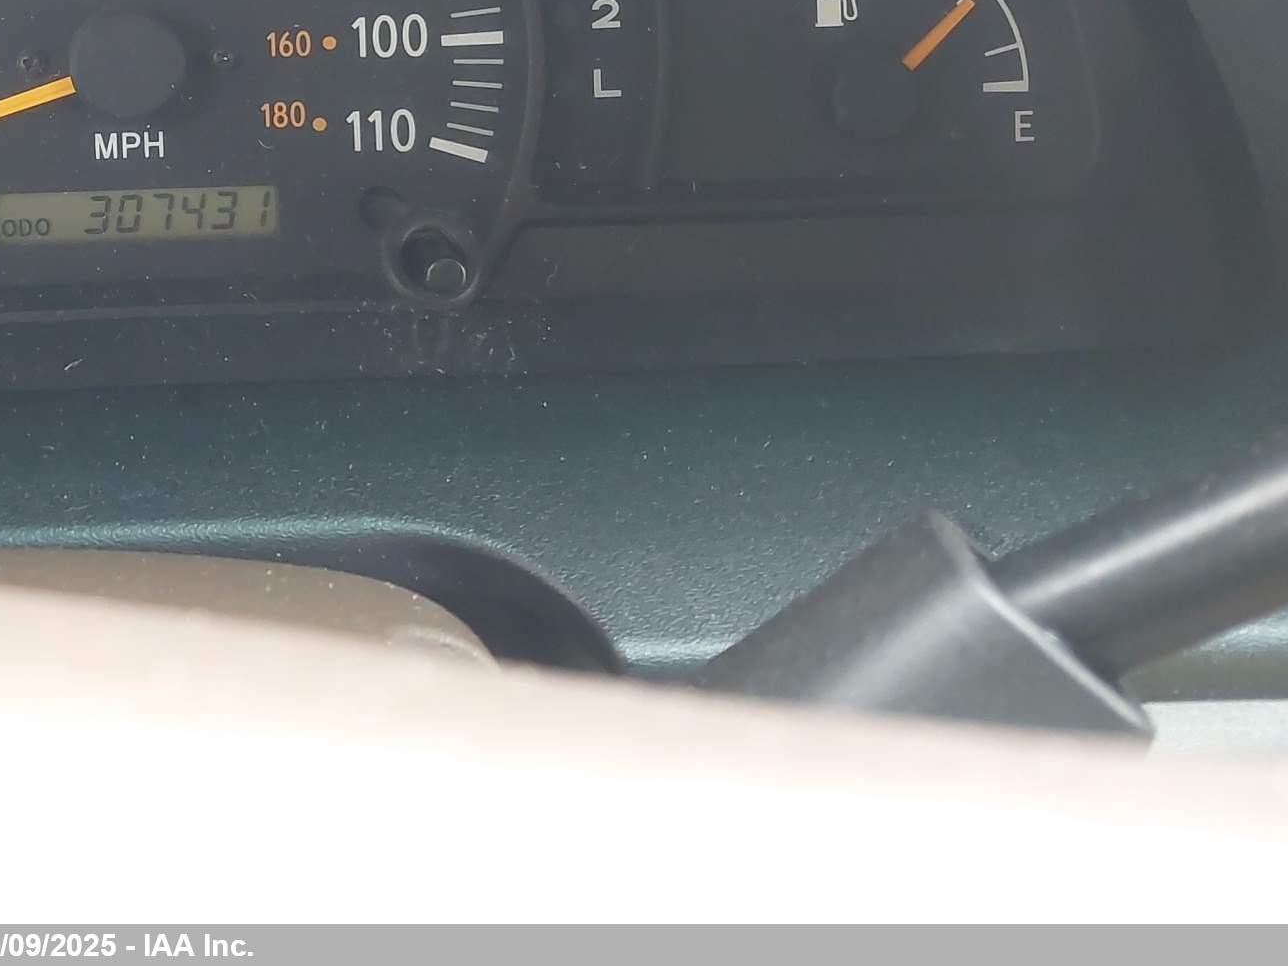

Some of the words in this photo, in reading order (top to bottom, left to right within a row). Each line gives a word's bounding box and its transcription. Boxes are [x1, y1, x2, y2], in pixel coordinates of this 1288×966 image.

[266, 30, 312, 58] 160
[351, 13, 429, 59] 100
[593, 68, 623, 98] L
[260, 101, 306, 129] 180
[345, 108, 417, 153] 110
[1014, 110, 1035, 142] E
[94, 131, 165, 160] MPH
[1, 217, 51, 238] ODO
[83, 190, 273, 236] 307431
